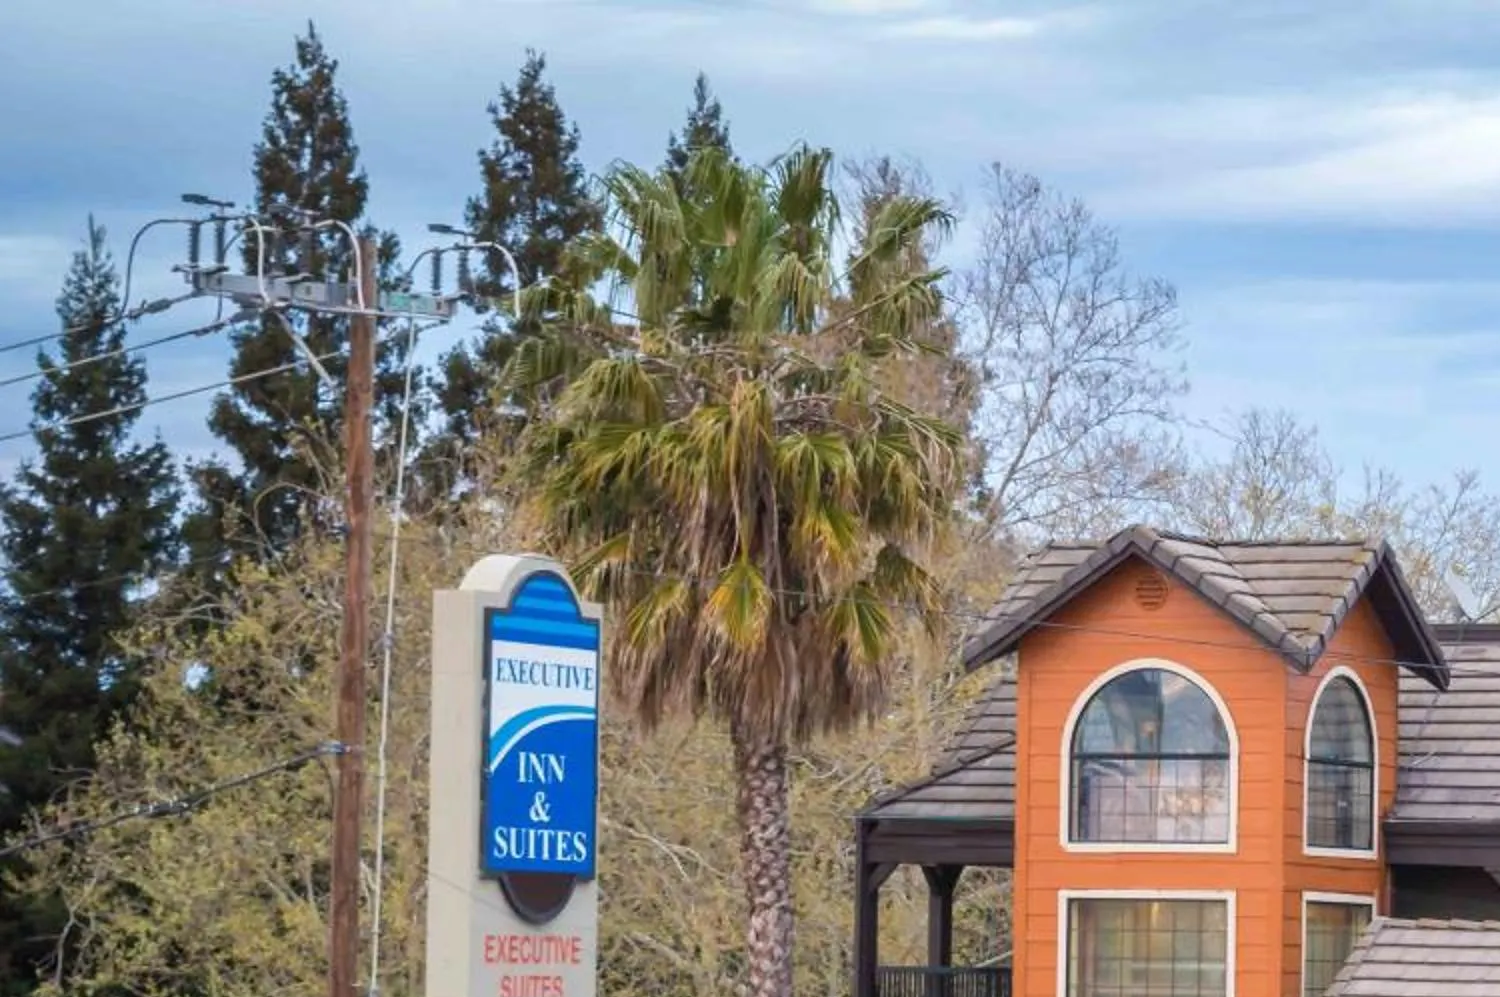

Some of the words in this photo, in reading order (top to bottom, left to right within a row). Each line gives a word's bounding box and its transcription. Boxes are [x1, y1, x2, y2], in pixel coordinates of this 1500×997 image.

[495, 657, 595, 691] EXECUTIVE
[517, 751, 566, 783] INN
[529, 791, 551, 822] &
[493, 827, 588, 862] SUITES
[484, 935, 582, 965] EXECUTIVE
